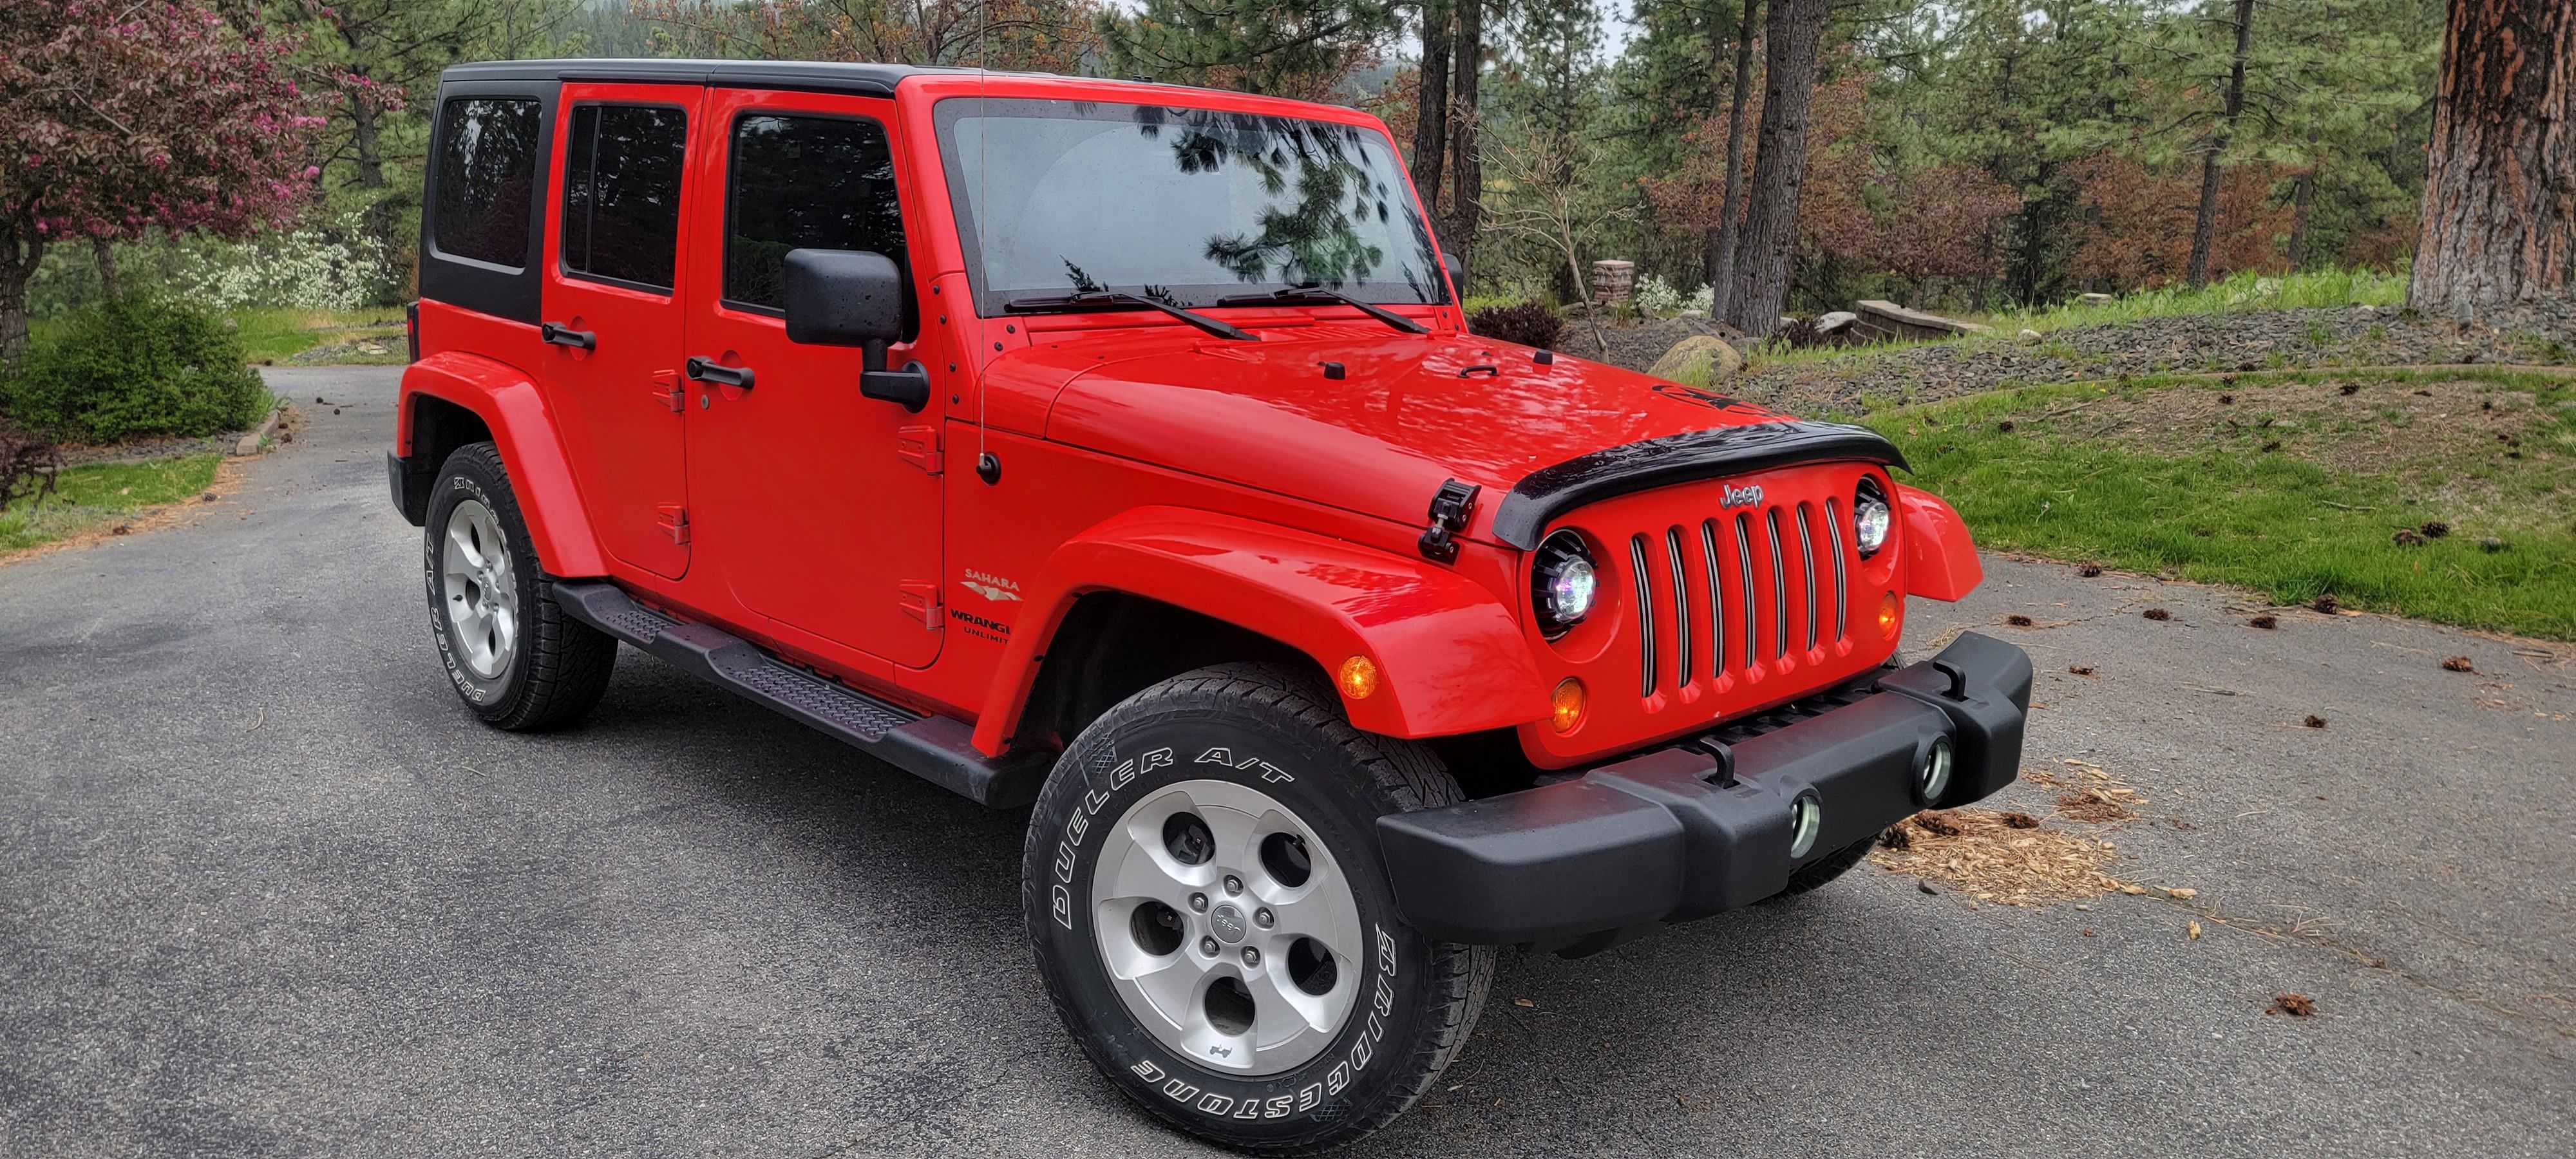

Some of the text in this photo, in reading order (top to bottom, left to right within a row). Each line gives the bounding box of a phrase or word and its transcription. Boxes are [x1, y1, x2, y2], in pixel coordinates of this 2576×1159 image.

[1719, 484, 1763, 509] Jeep
[965, 569, 1020, 592] SAHARA
[951, 608, 1010, 635] WRANGL
[964, 627, 1009, 645] UNLIMIT
[431, 606, 487, 702] DUELER
[1052, 747, 1173, 930] DUELER
[1194, 747, 1295, 784] A/T
[1130, 921, 1397, 1120] BRIDGESTONE
